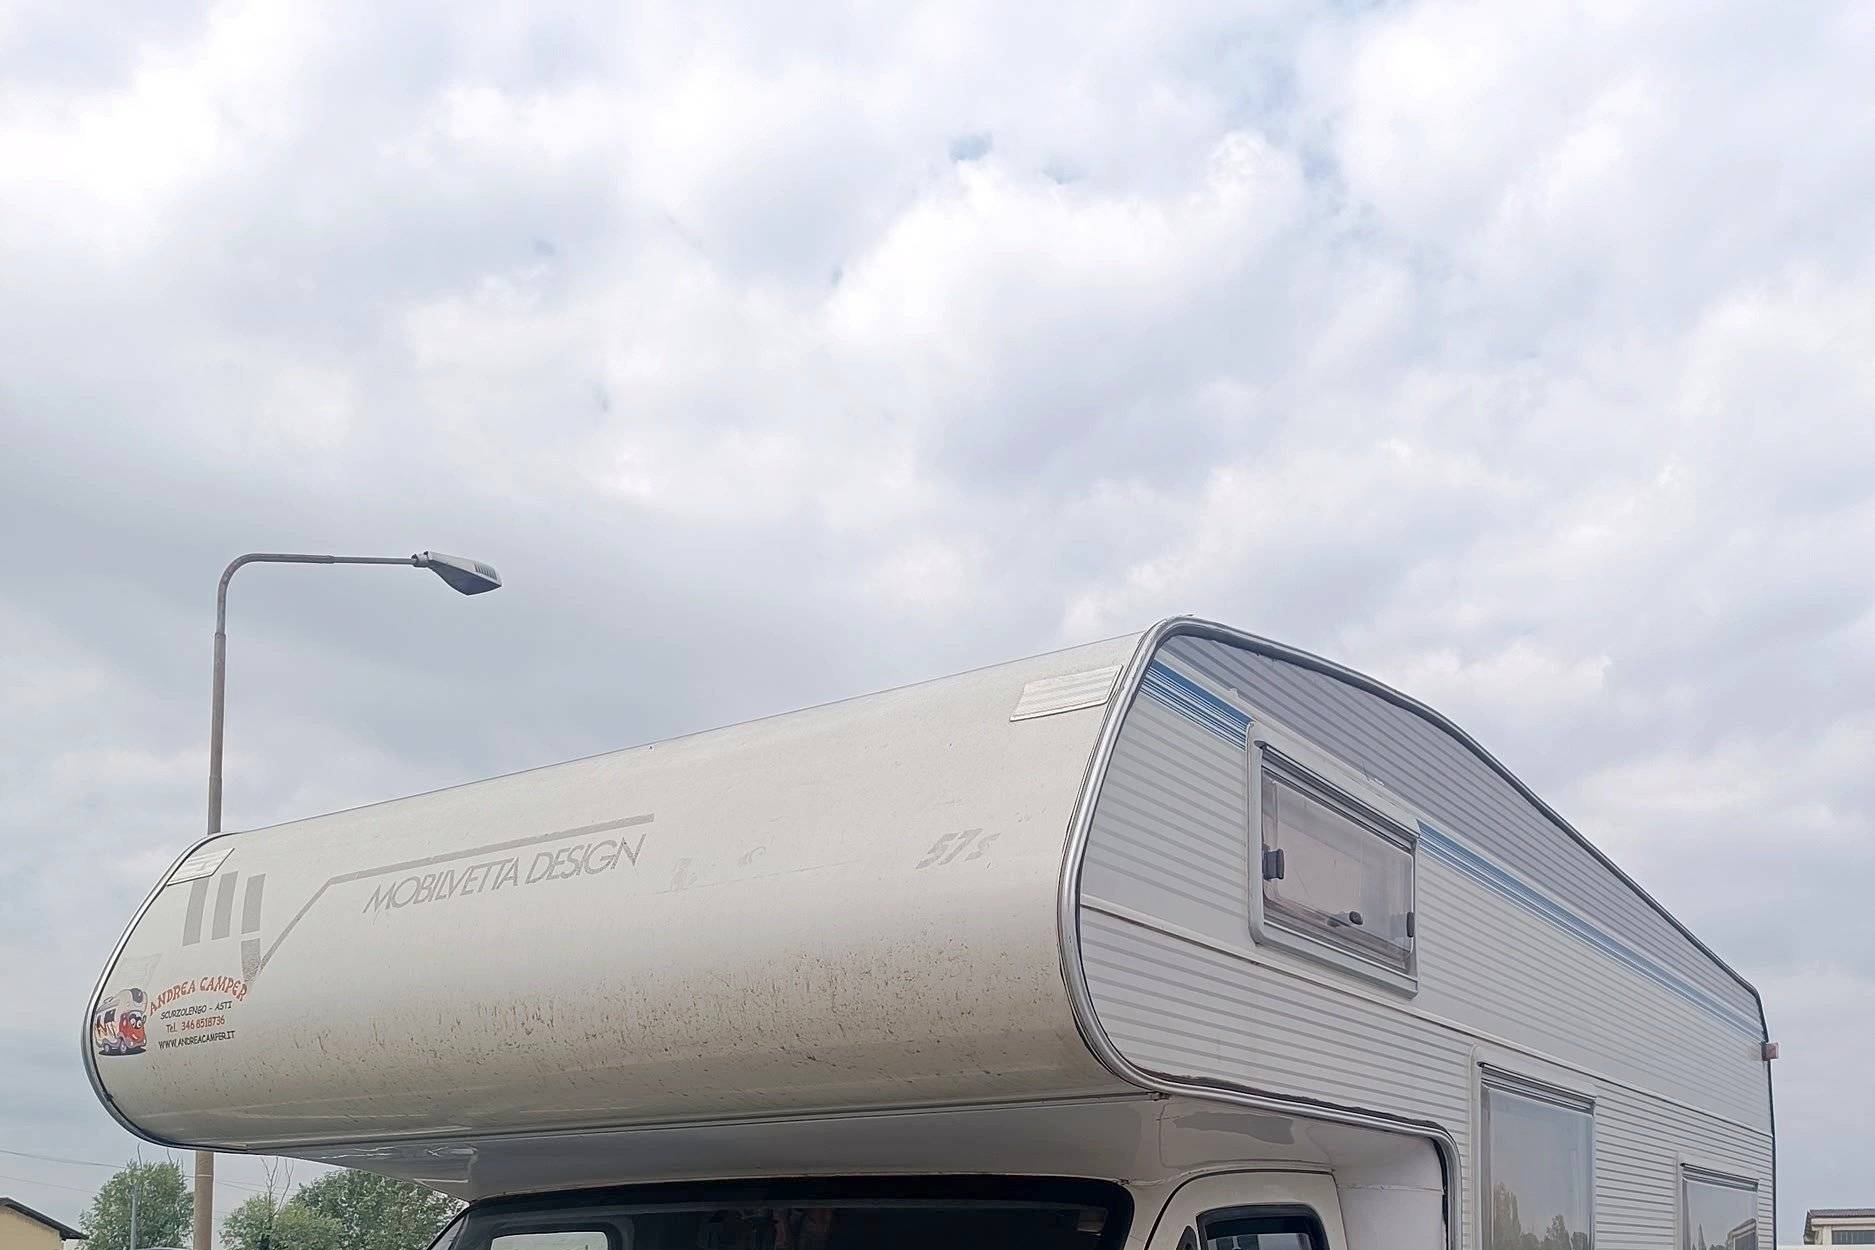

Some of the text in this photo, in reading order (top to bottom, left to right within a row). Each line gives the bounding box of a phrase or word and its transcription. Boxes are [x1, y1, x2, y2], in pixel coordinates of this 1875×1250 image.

[362, 833, 647, 913] MOBILVETTA DESIGN
[149, 976, 248, 1016] ANDREA CAMPER
[160, 1005, 207, 1020] SCURZOLENGO
[214, 1001, 233, 1011] ASTI
[158, 1030, 236, 1051] WWW.ANDREACAMPER.IT
